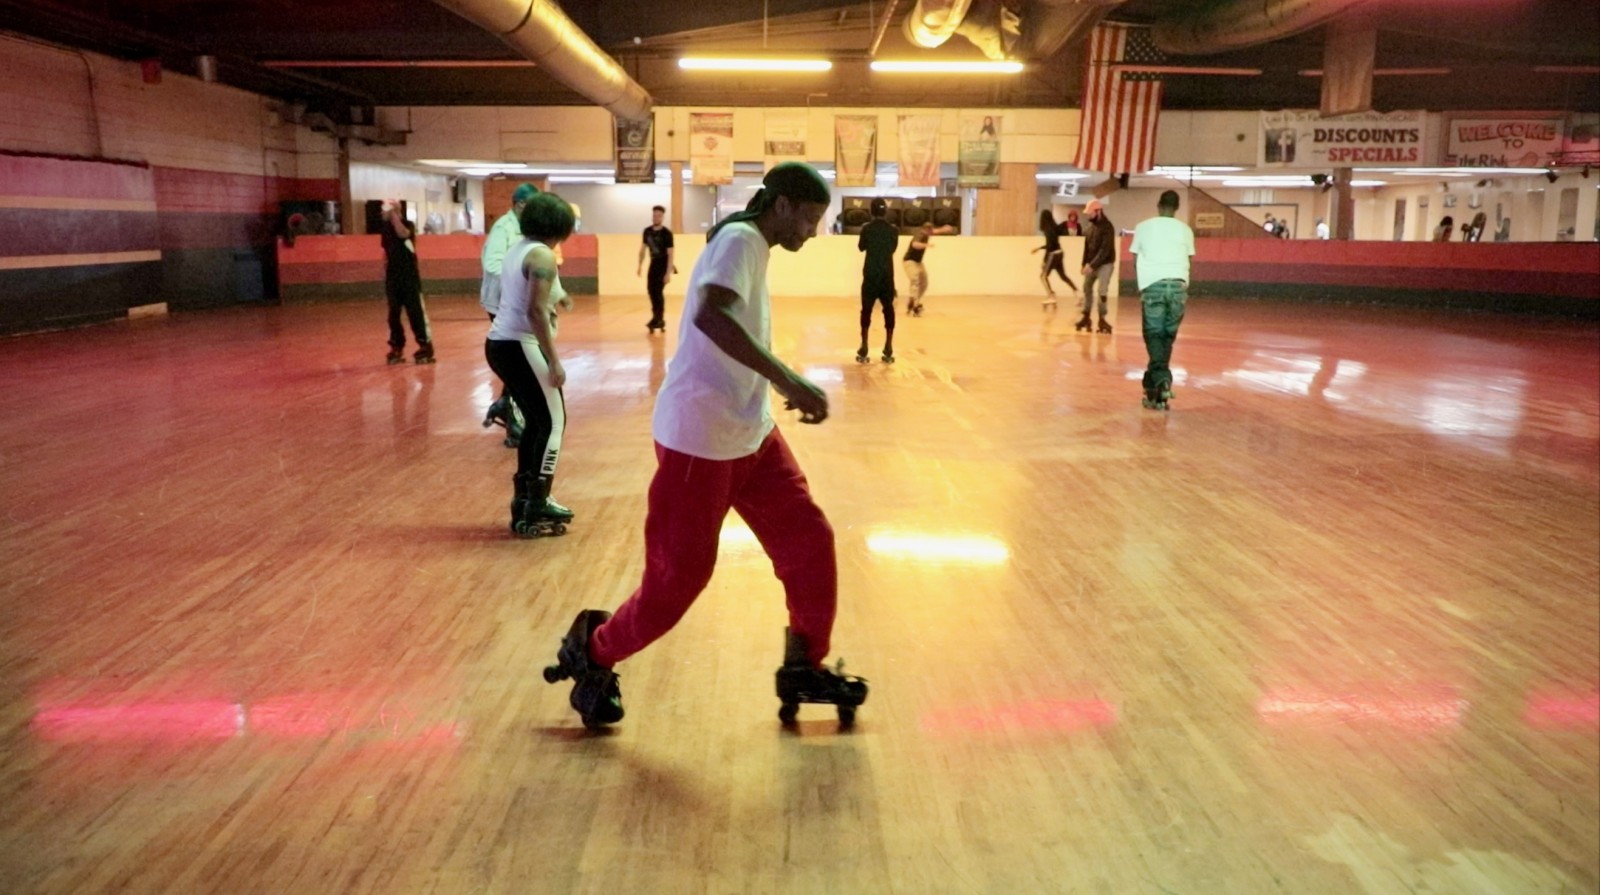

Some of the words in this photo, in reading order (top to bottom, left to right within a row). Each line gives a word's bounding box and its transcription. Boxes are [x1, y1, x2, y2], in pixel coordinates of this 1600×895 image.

[1313, 128, 1419, 143] DISCOUNTS
[1458, 122, 1556, 142] WELCOME
[1502, 138, 1524, 149] TO
[1328, 147, 1418, 162] SPECIALS
[542, 448, 559, 472] PINK
